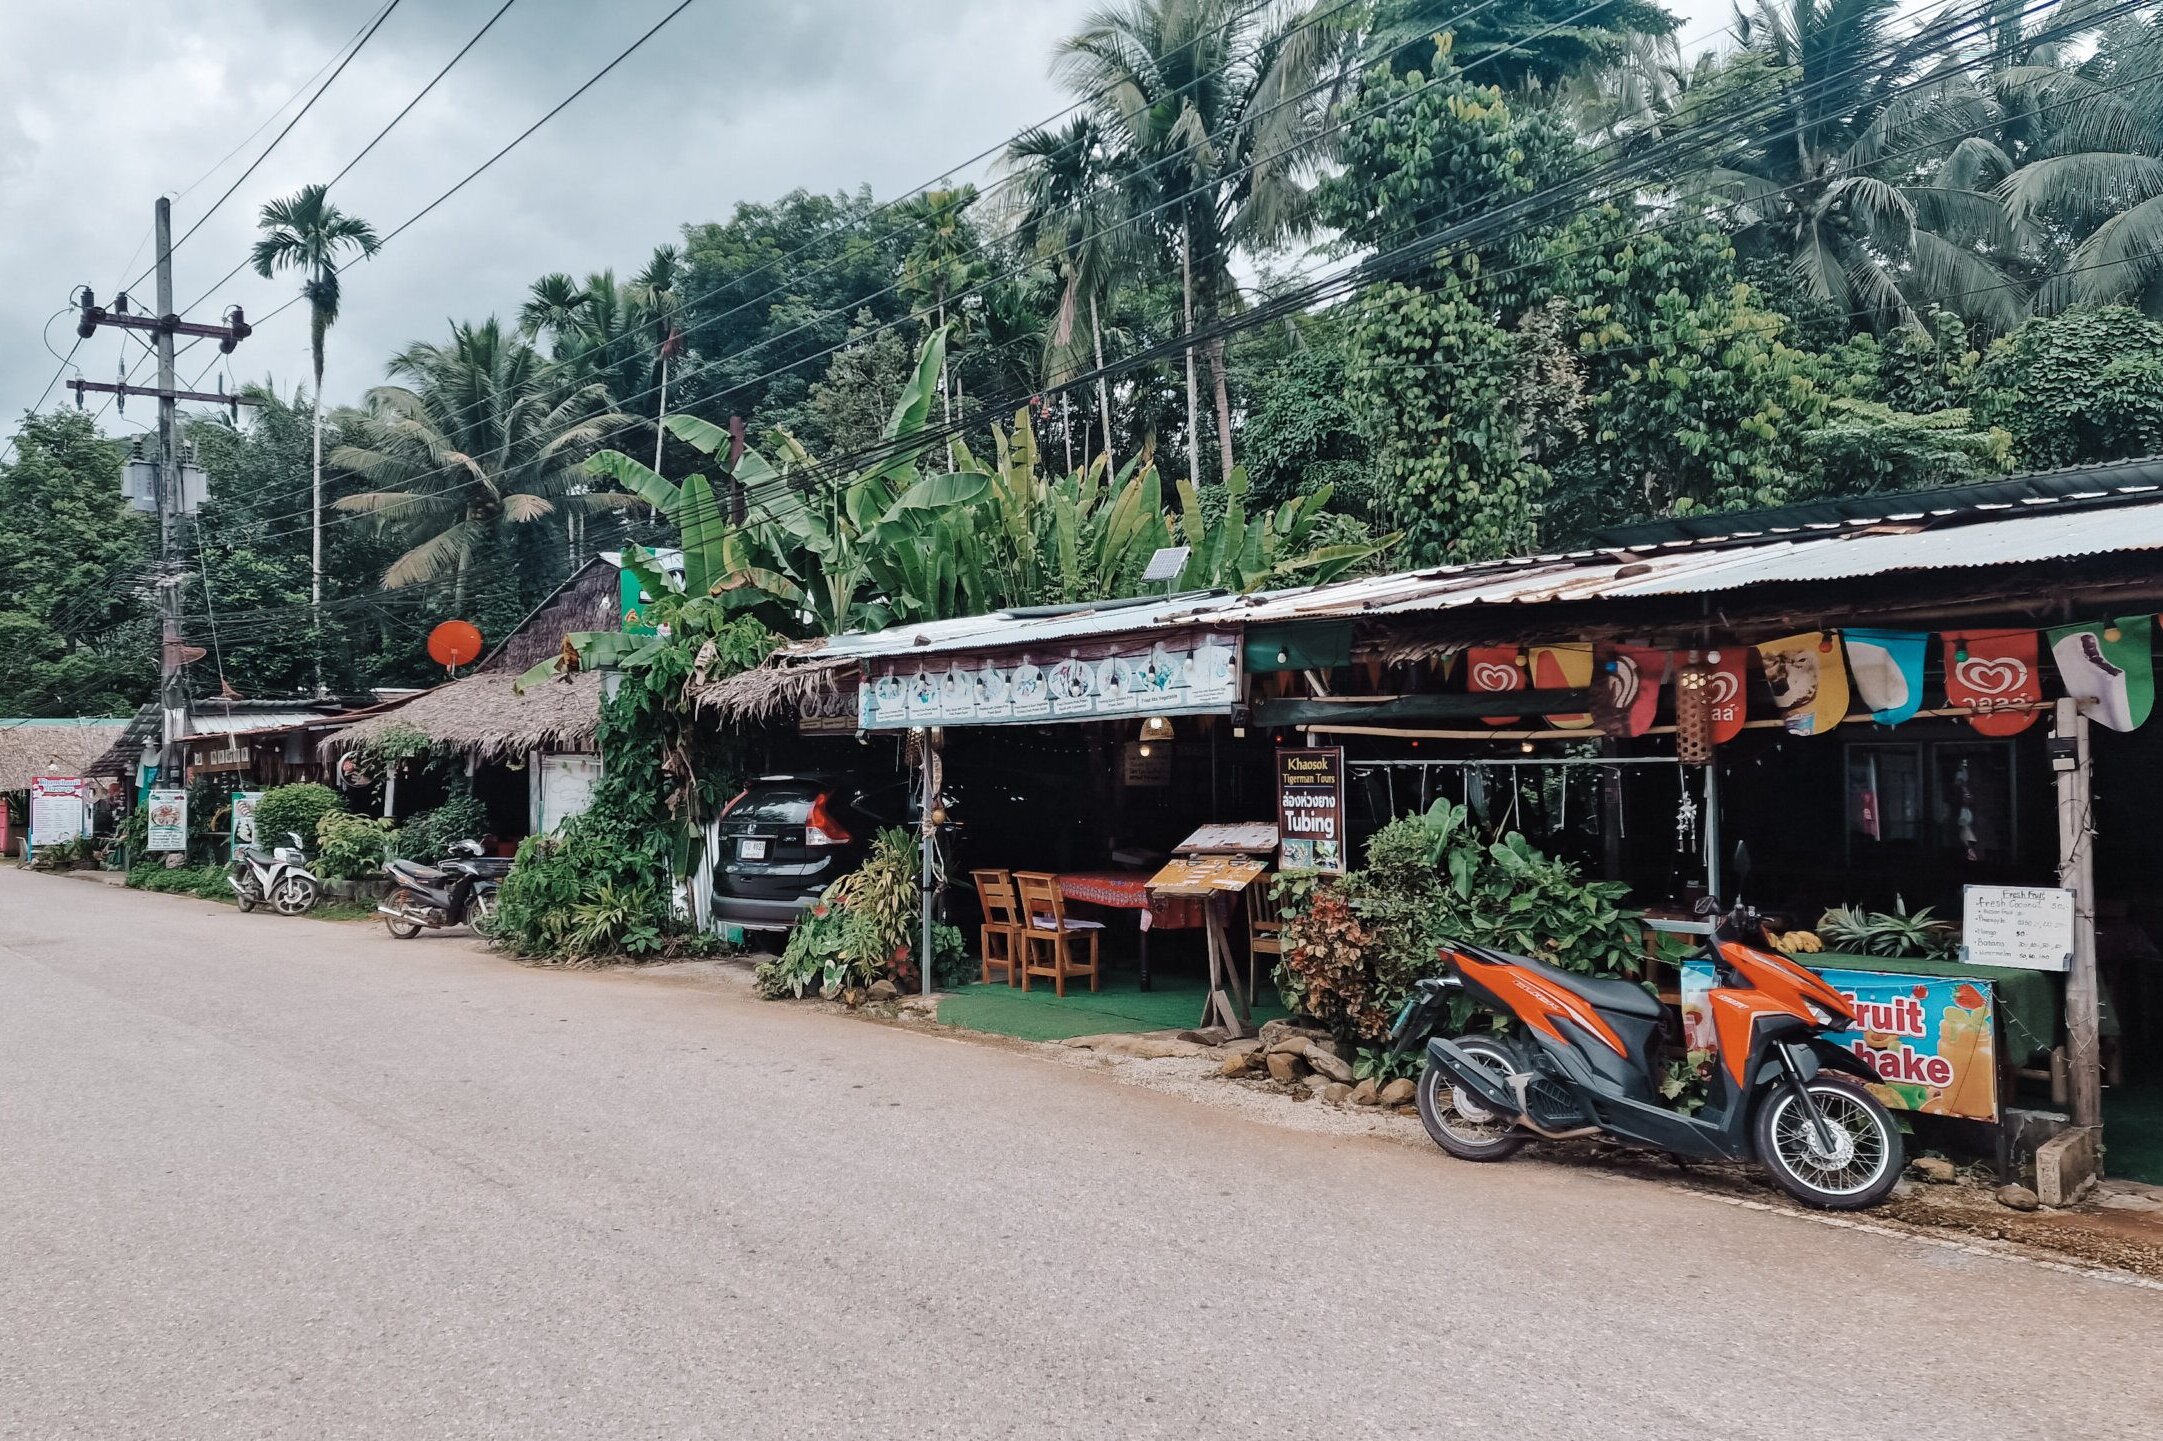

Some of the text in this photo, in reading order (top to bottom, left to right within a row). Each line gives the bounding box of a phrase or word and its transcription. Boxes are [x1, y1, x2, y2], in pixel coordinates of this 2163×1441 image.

[1287, 757, 1328, 771] Khaosok
[1282, 773, 1336, 785] Tigerman Tours
[1282, 791, 1336, 808] ล่องห่วงยาง
[1284, 810, 1335, 839] Tubing
[2003, 890, 2046, 901] Fresh Fruit
[1854, 1042, 1951, 1084] hake
